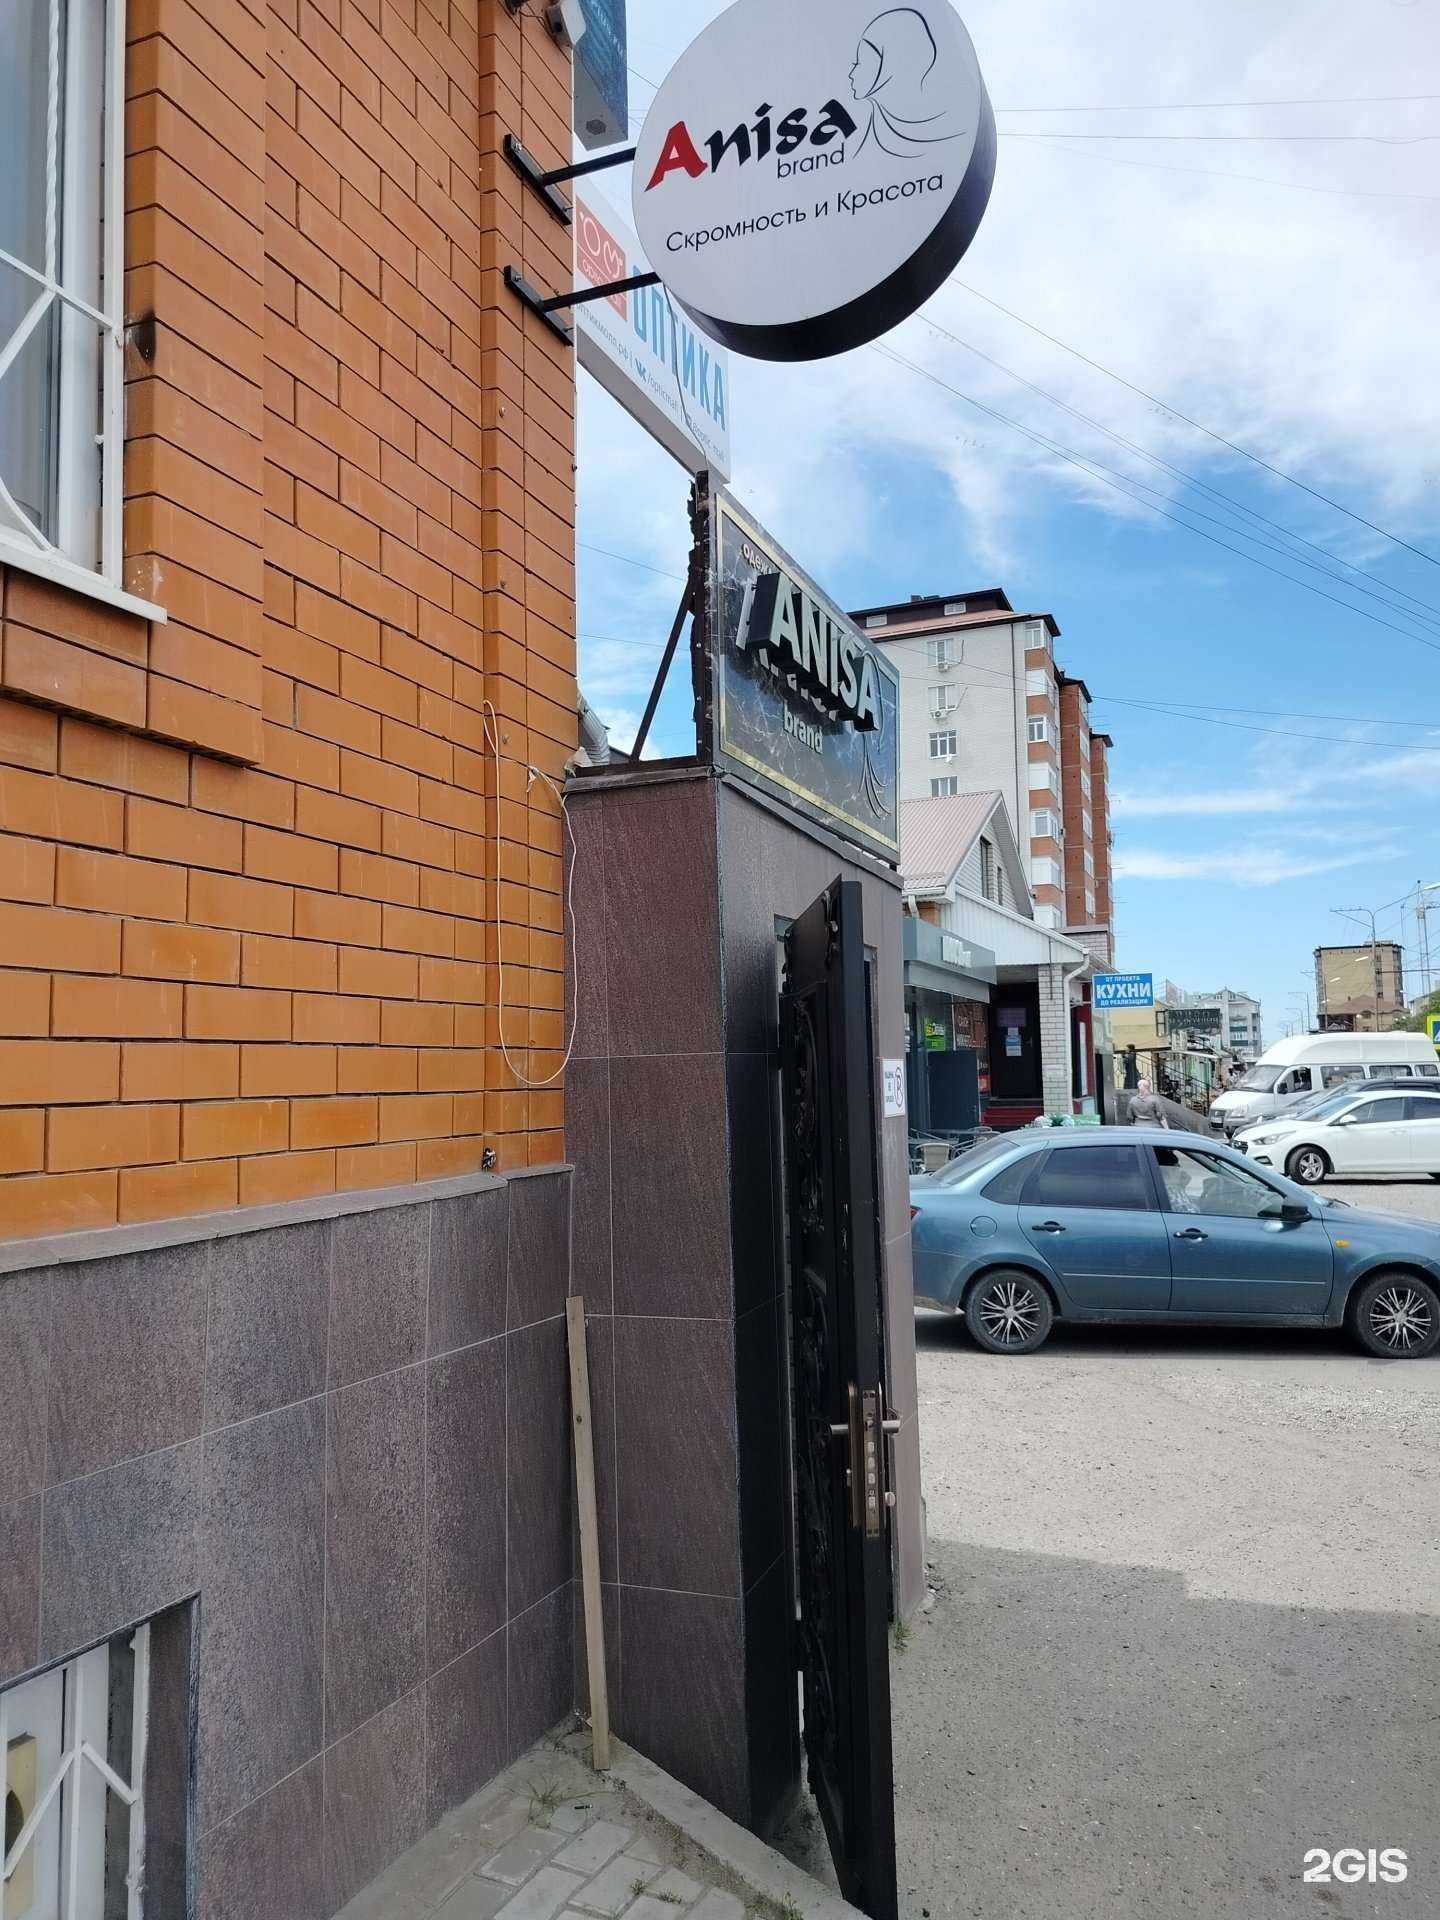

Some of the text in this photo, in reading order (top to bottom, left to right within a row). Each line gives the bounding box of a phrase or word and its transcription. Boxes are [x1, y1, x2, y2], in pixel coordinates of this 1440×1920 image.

[645, 99, 857, 192] Anisa
[777, 142, 845, 179] brand
[665, 173, 943, 251] Скромность и Красота
[632, 264, 726, 432] ОПТИКА
[768, 572, 880, 731] ANISA
[783, 699, 823, 754] brand
[1096, 982, 1151, 999] КУХНИ
